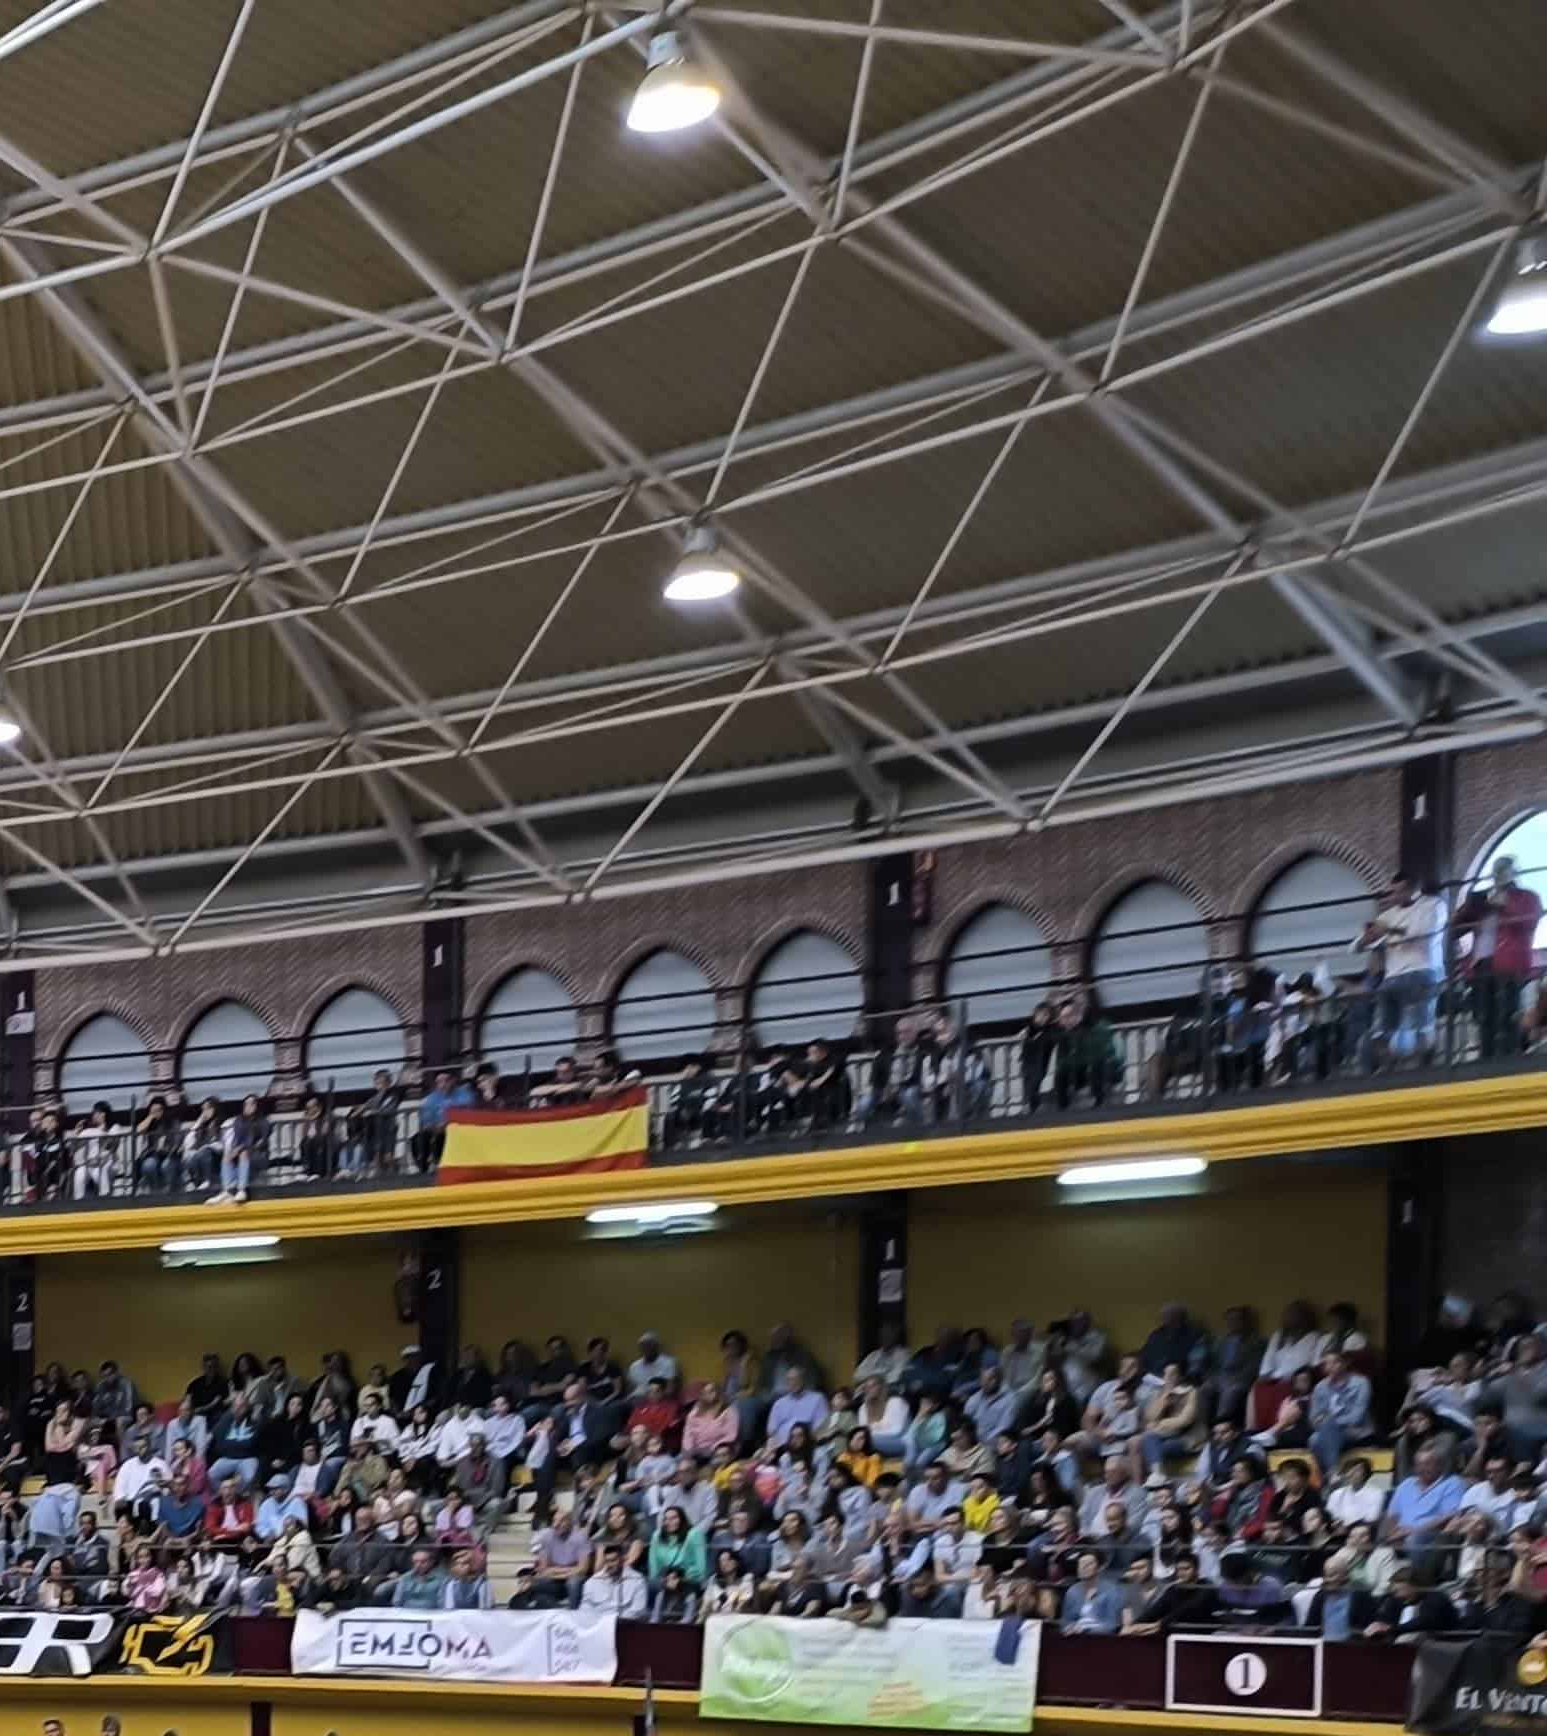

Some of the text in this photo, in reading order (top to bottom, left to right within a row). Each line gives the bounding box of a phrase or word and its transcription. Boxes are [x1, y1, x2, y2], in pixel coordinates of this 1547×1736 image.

[887, 880, 899, 906] 1
[433, 944, 444, 969] 1
[16, 991, 26, 1011] 1
[885, 1238, 896, 1262] 1
[427, 1268, 442, 1290] 2
[15, 1292, 28, 1313] 2
[350, 1632, 493, 1658] EMJOMA
[1237, 1657, 1251, 1689] 1
[1455, 1686, 1483, 1710] EL
